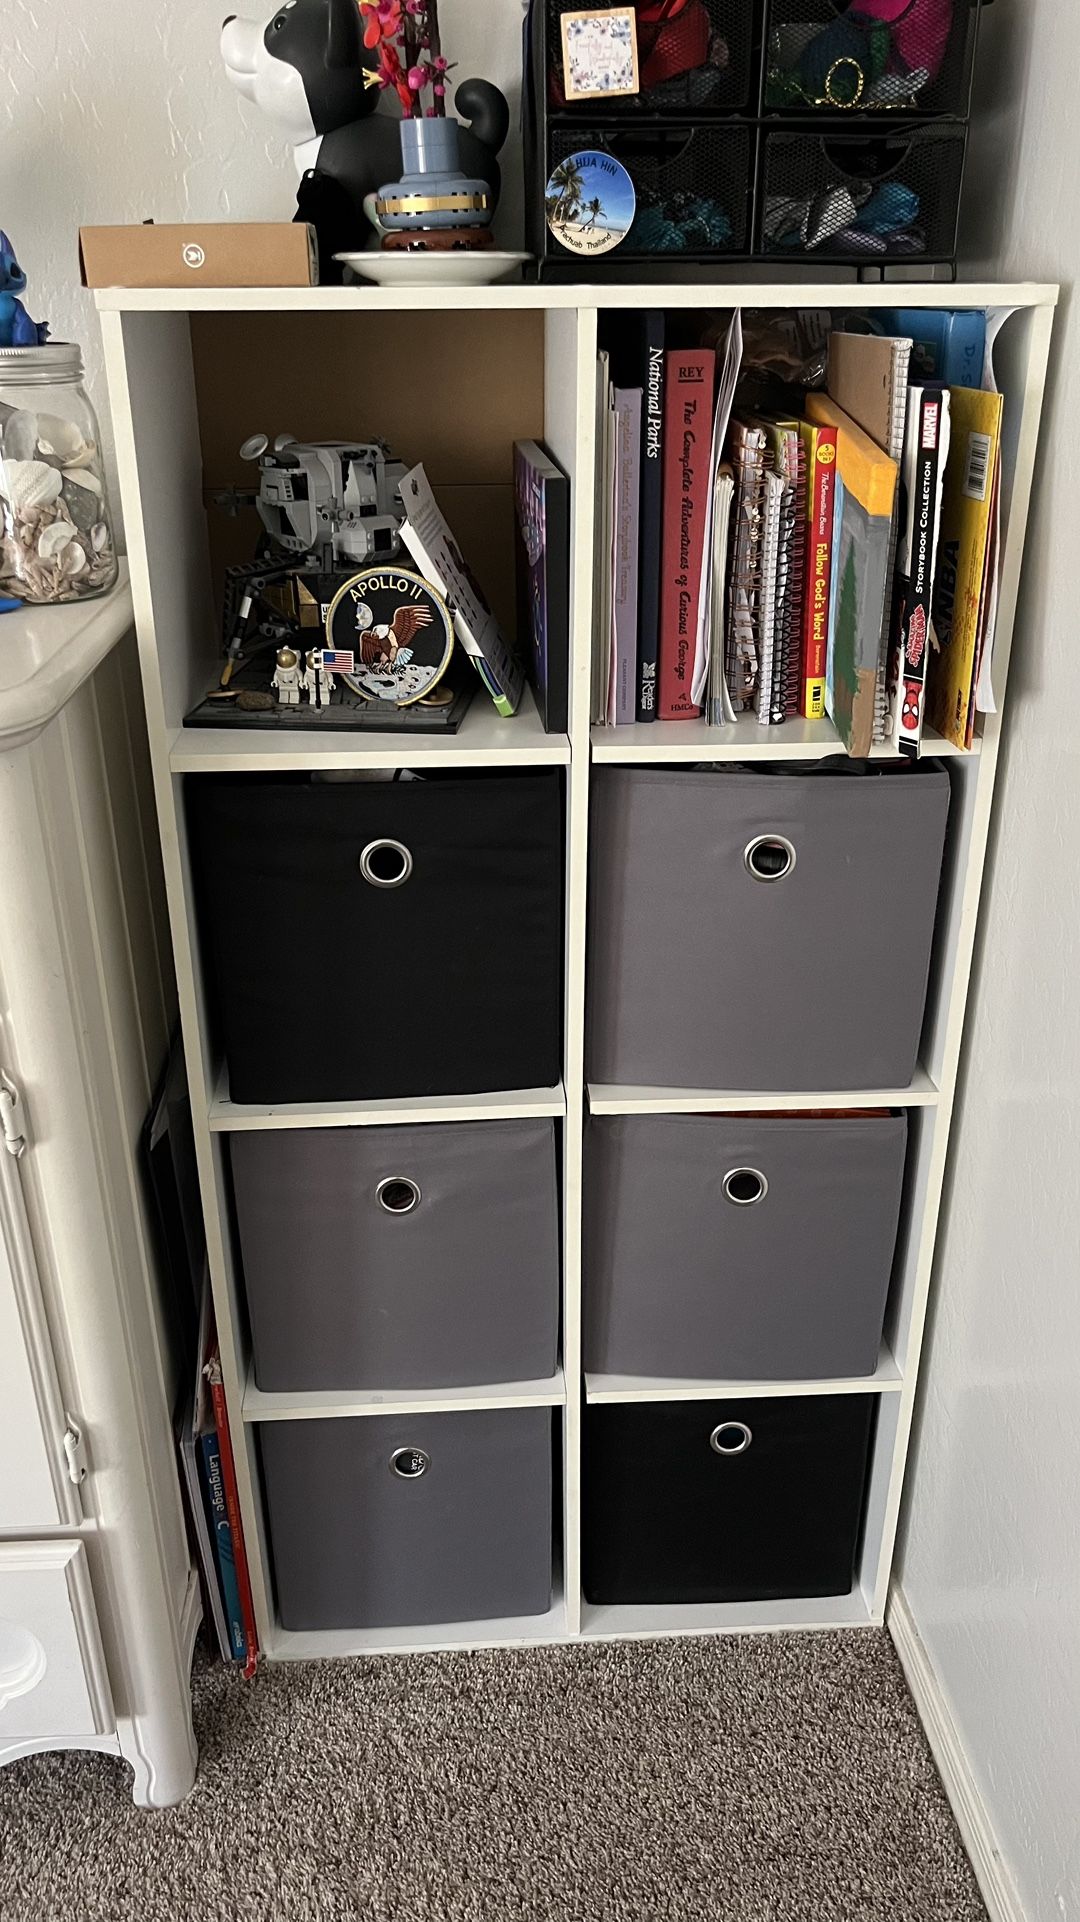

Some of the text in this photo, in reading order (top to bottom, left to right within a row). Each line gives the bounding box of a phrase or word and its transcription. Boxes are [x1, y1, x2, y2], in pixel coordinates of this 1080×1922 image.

[575, 157, 618, 176] HUA HIN
[586, 232, 612, 249] Thailand
[678, 366, 704, 378] REY
[962, 343, 976, 368] Dr.
[647, 346, 663, 459] National Parks
[922, 402, 938, 449] MARVEL
[821, 472, 829, 484] The
[673, 399, 697, 681] The Complete Adventures of Curious George
[915, 460, 932, 594] STORYBOOK COLLECTION
[349, 575, 409, 603] APOLLO
[813, 543, 827, 640] Follow God's Word
[208, 1454, 229, 1530] Language C
